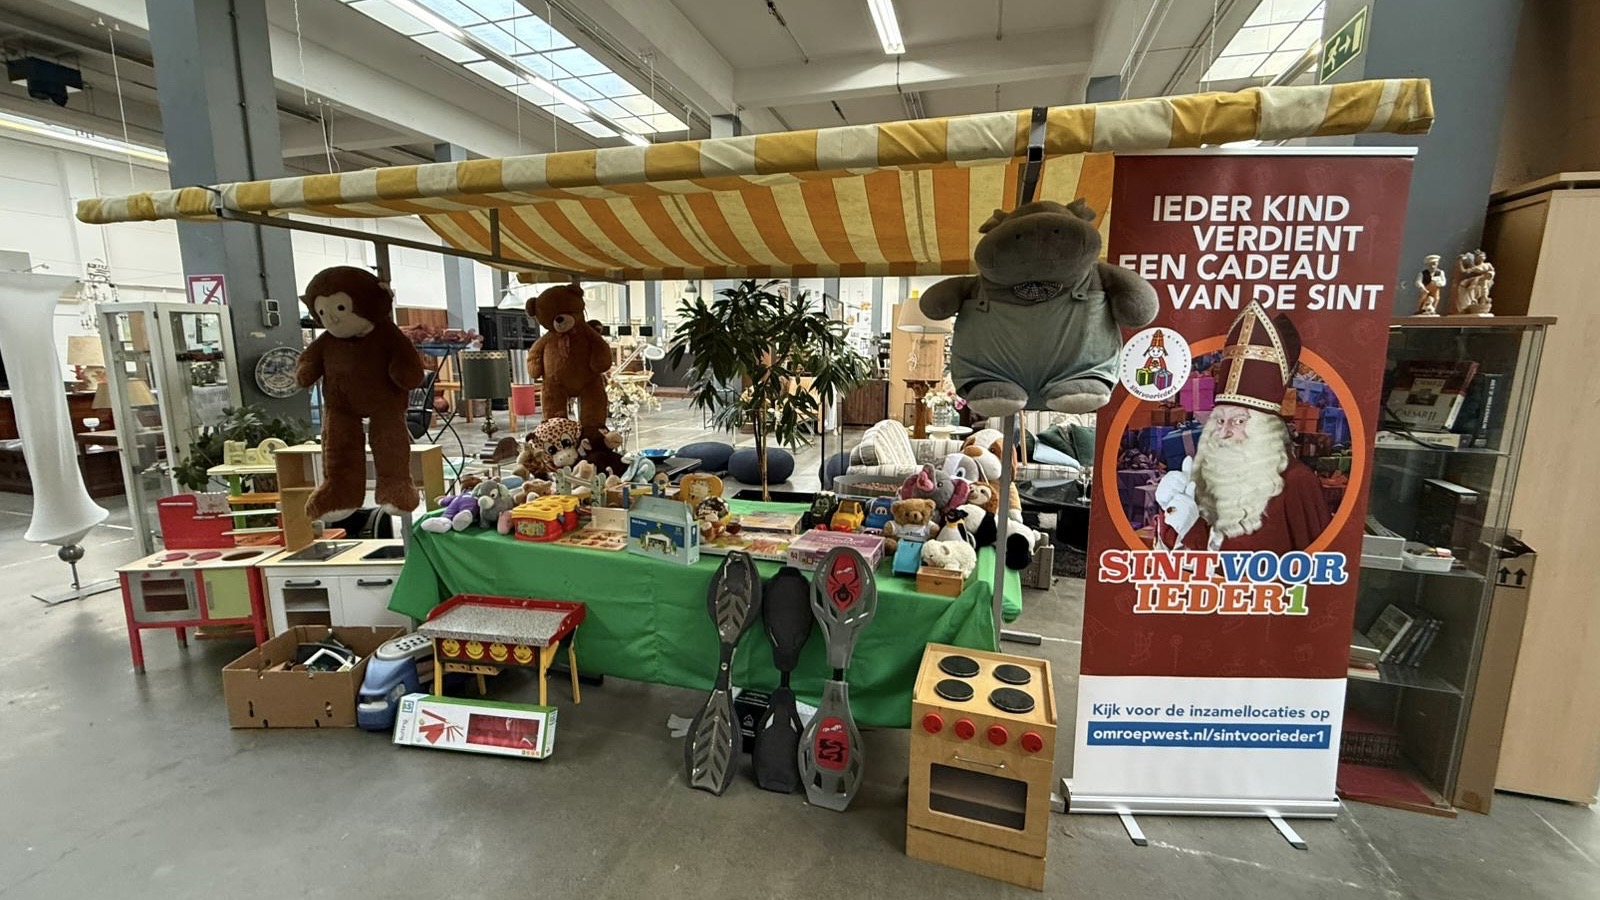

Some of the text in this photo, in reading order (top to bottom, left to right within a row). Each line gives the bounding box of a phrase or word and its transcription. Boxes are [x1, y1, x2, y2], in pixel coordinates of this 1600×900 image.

[1152, 195, 1350, 222] IEDER KIND
[1193, 225, 1364, 252] VERDIENT
[1119, 254, 1340, 280] EEN CADEAU
[1167, 284, 1384, 310] VAN DE SINT
[1099, 550, 1348, 583] SINTVOOR
[1134, 582, 1308, 615] IEDER1
[1093, 703, 1330, 721] Kijk voor de inzamellocaties op
[1093, 728, 1324, 744] omroepwest.nl/sintvoorieder1
